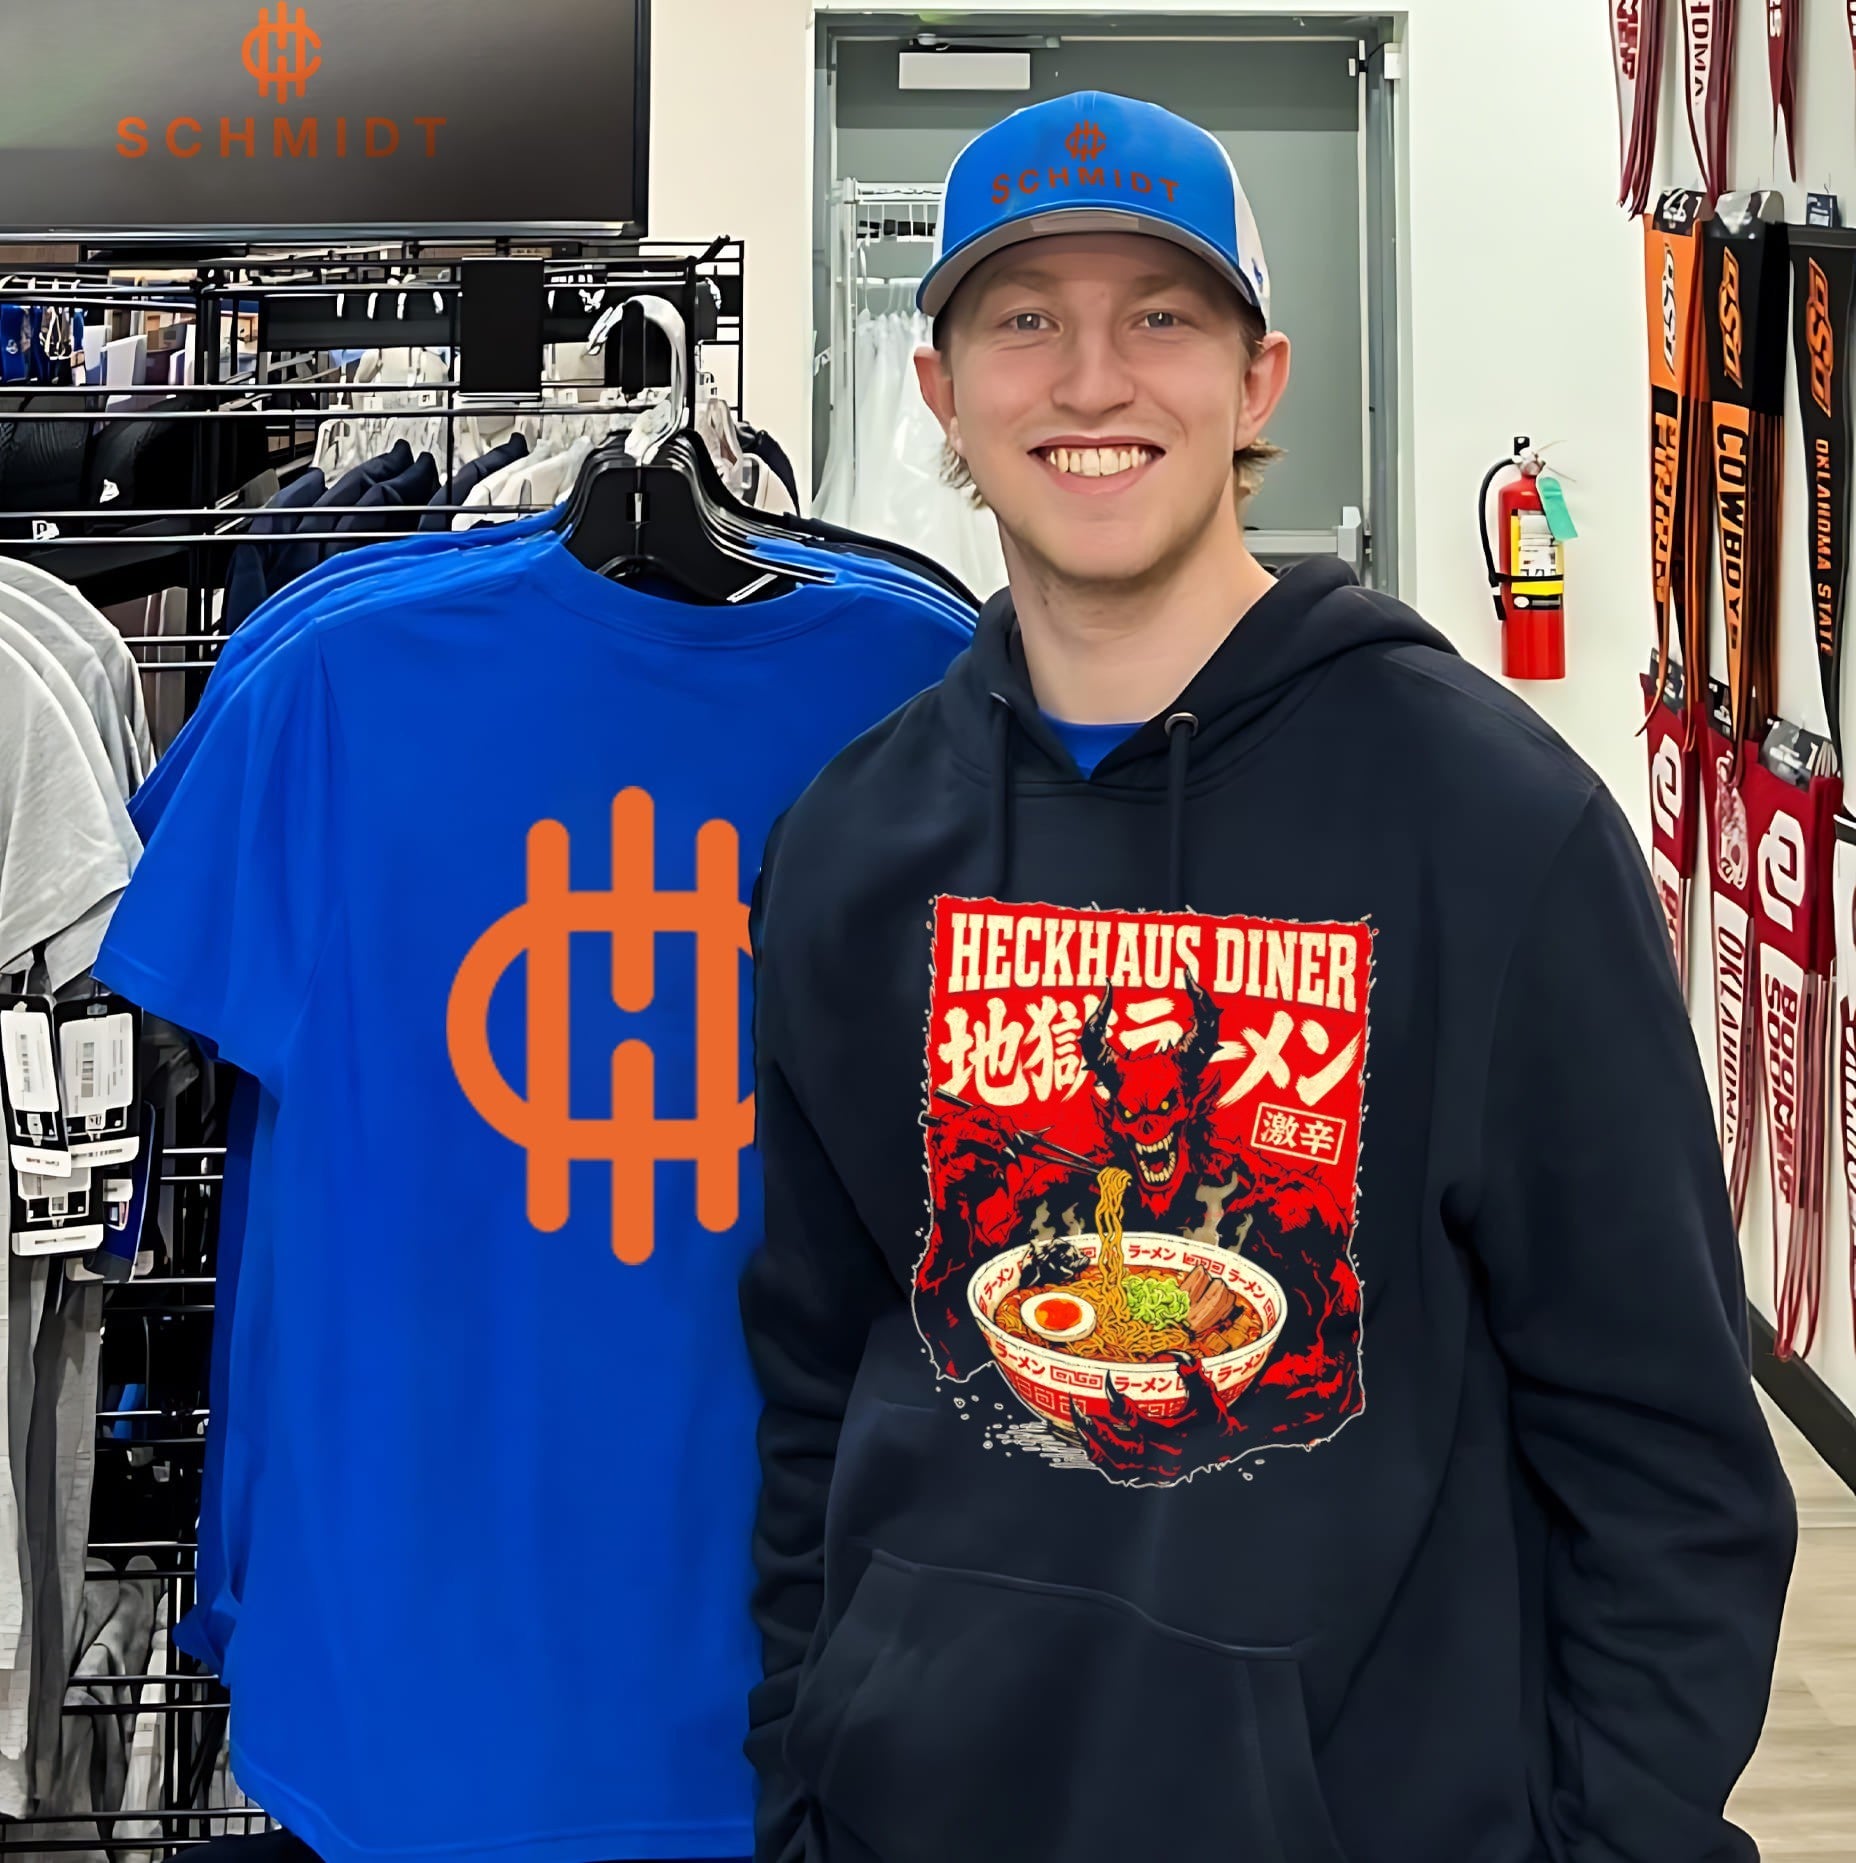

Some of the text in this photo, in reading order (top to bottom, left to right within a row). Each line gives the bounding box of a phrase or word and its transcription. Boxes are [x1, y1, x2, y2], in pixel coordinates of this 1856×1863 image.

[116, 117, 447, 158] SCHMIDT
[991, 167, 1179, 205] SCHMIDT
[947, 913, 1358, 1013] HECKHAUS DINER
[1259, 1110, 1337, 1155] 激辛
[1128, 1245, 1177, 1262] ラーメン
[1228, 1268, 1266, 1298] ラーメン
[995, 1343, 1046, 1376] ラーメン
[1217, 1351, 1266, 1383] ラーメン
[1114, 1376, 1173, 1394] ラーメン
